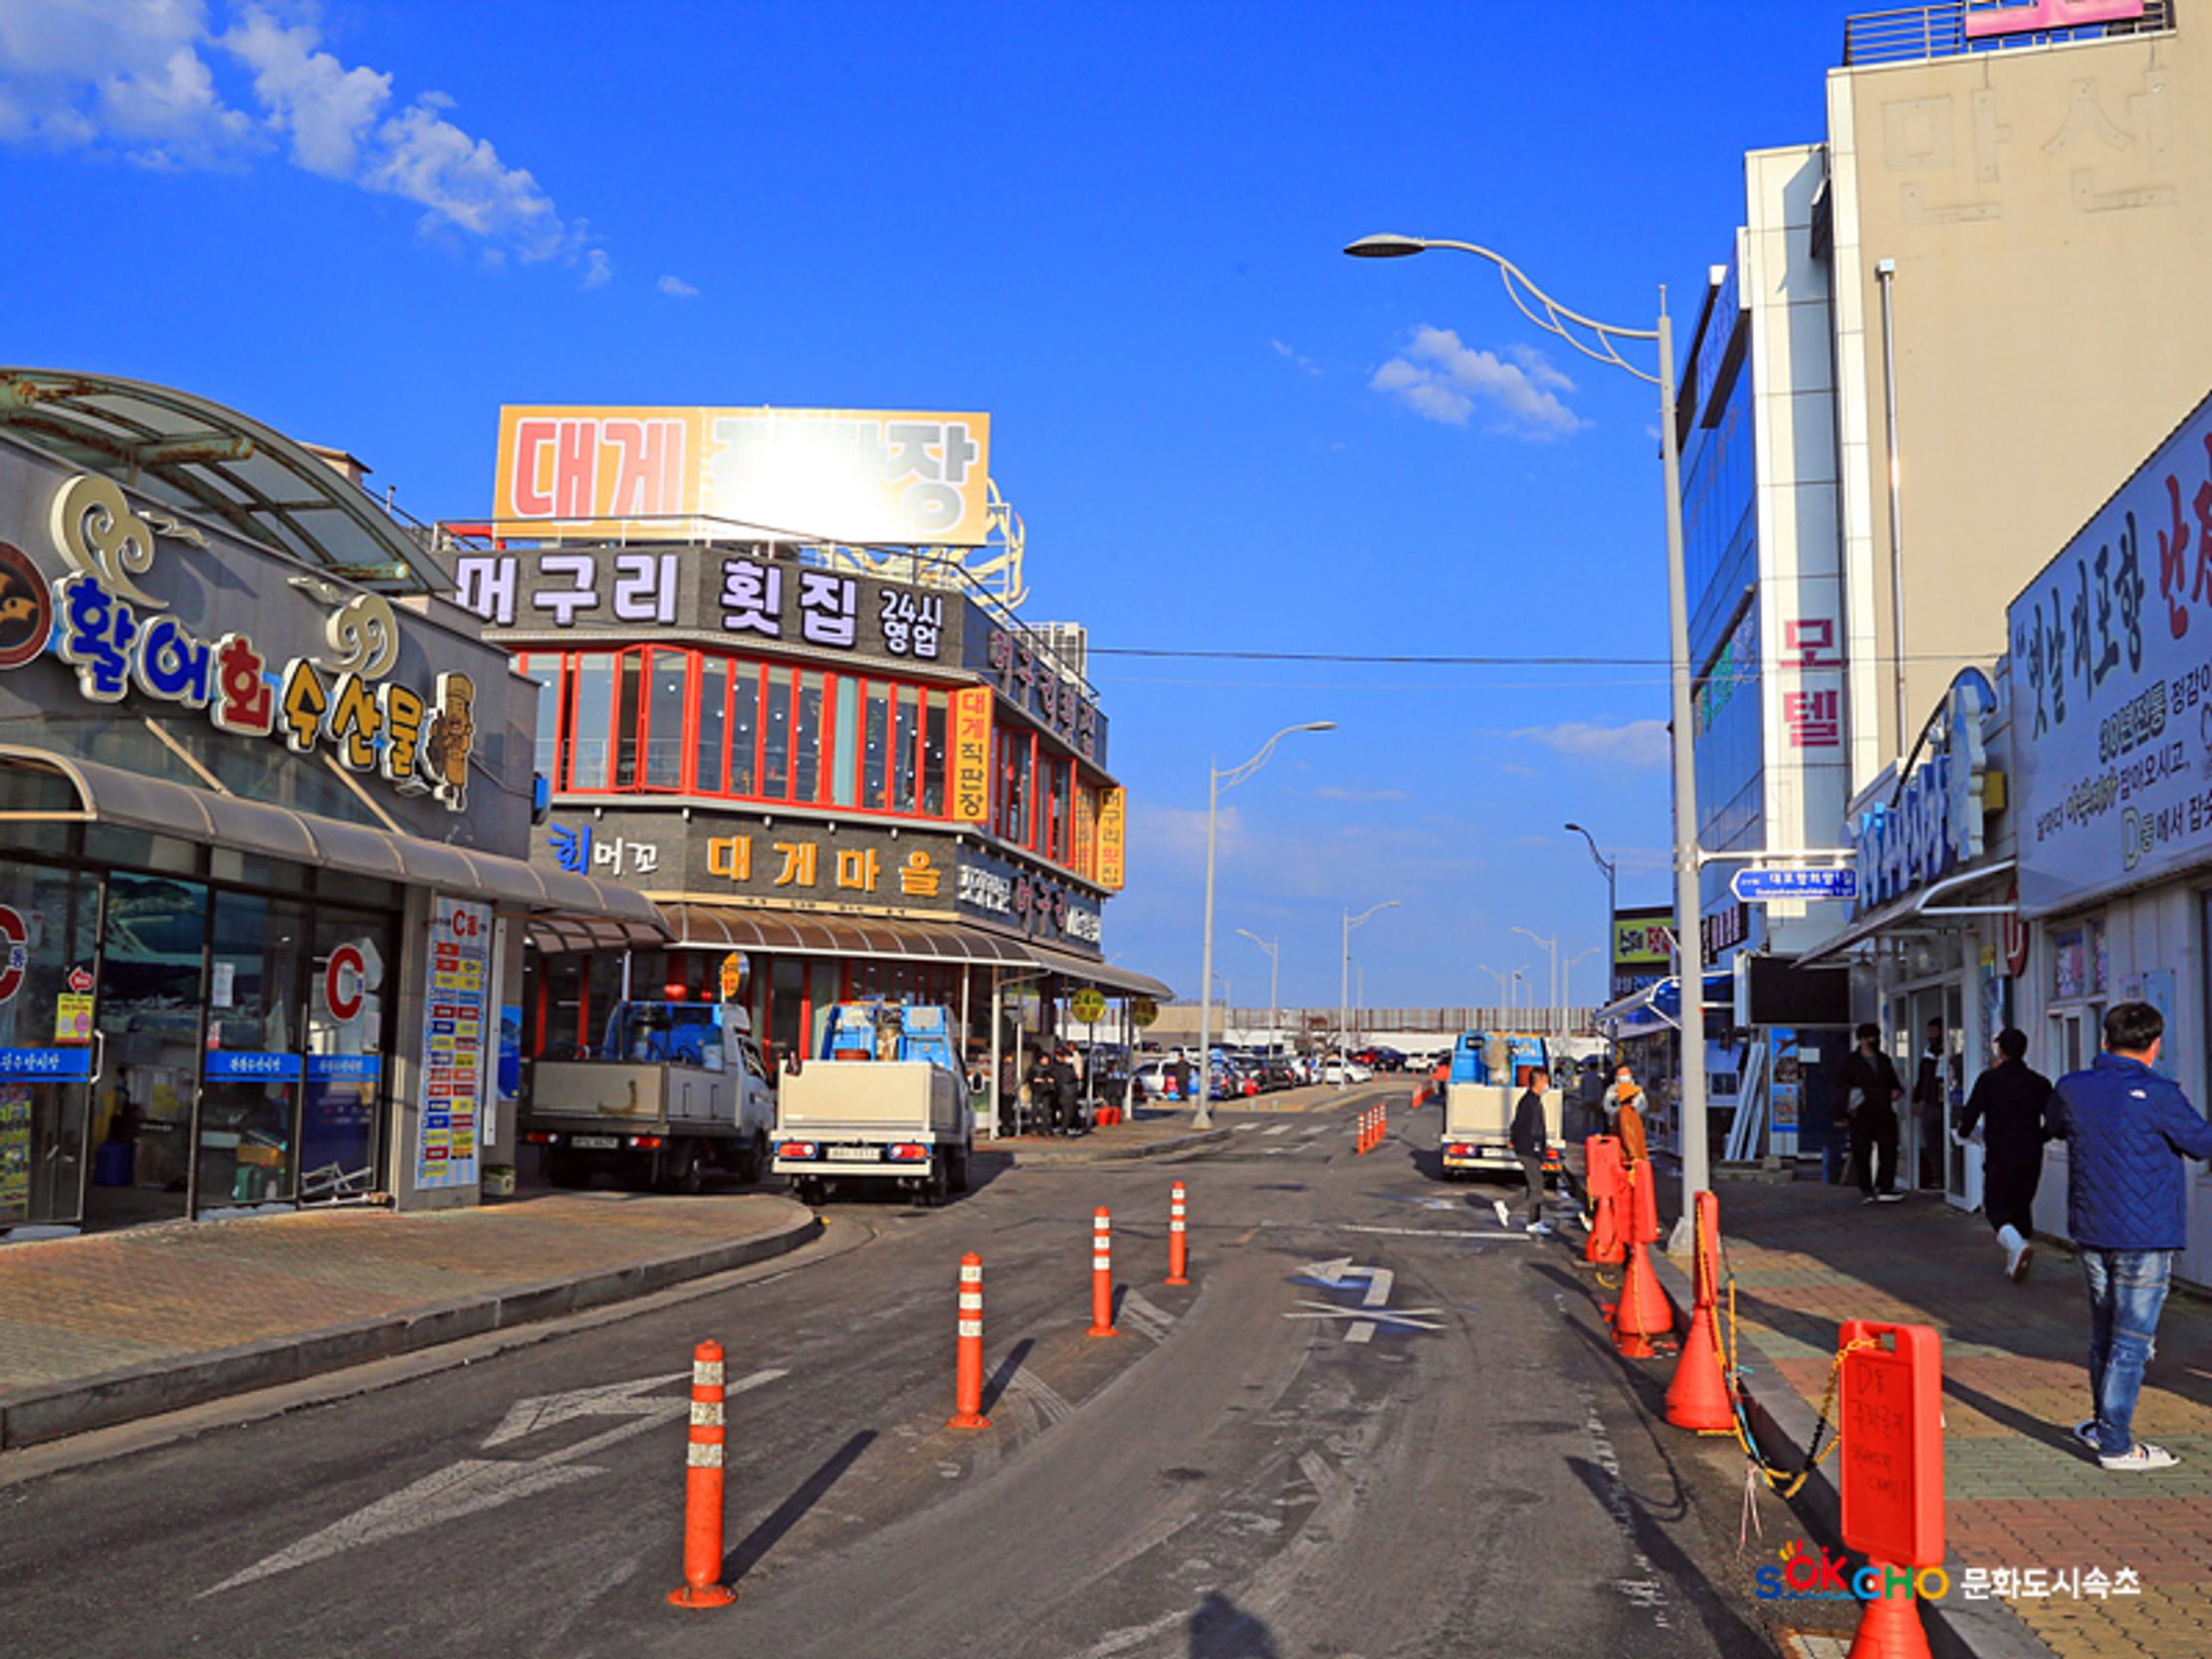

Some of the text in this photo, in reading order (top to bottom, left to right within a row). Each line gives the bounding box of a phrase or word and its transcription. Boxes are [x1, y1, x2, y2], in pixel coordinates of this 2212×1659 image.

[514, 419, 685, 525] 대게
[456, 554, 856, 647] 머구리 횟집
[881, 590, 942, 626] 24시
[884, 621, 938, 657] 영업
[1780, 618, 1842, 748] 모텔
[707, 835, 942, 897] 대게마을
